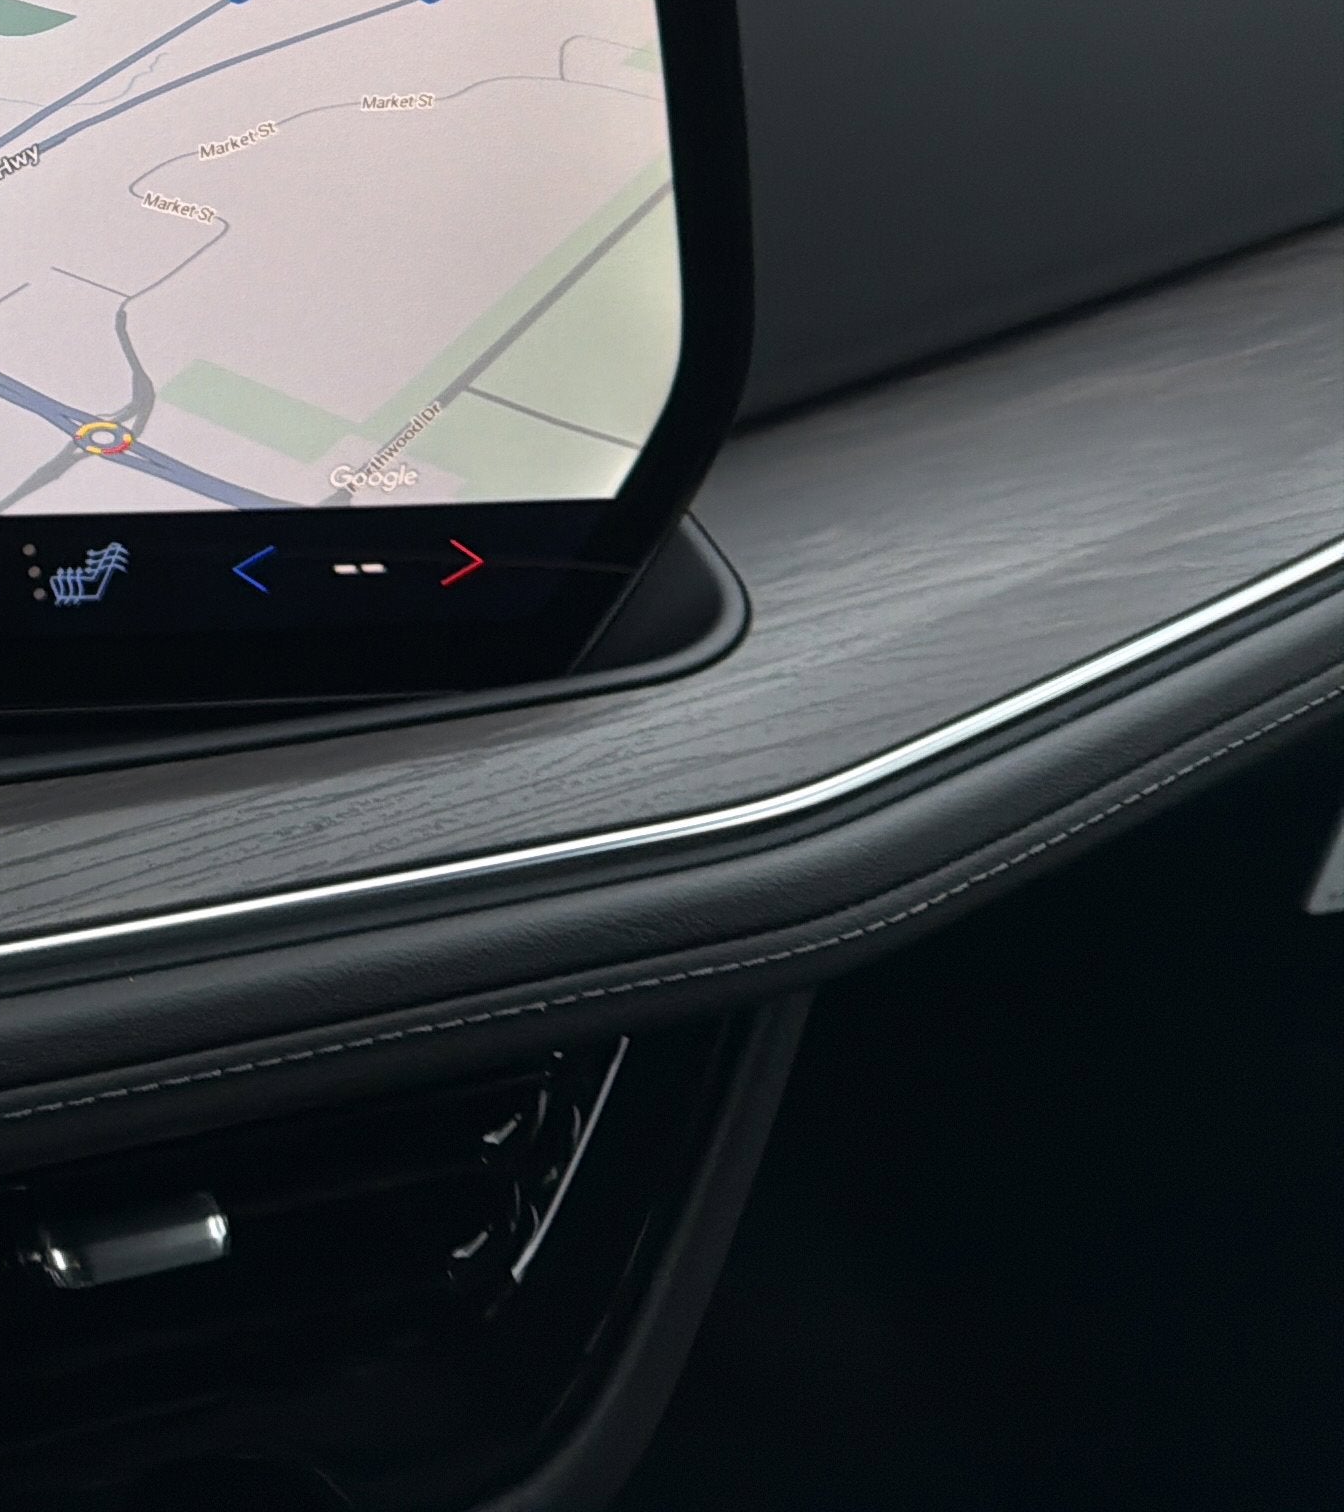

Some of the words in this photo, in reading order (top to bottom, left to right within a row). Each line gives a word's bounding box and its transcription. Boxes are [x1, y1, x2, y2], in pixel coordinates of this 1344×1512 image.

[362, 96, 413, 110] Market
[416, 94, 433, 107] St
[199, 133, 254, 158] Market
[258, 122, 276, 137] St
[143, 192, 196, 218] Market
[198, 207, 215, 222] St
[330, 464, 418, 493] Google
